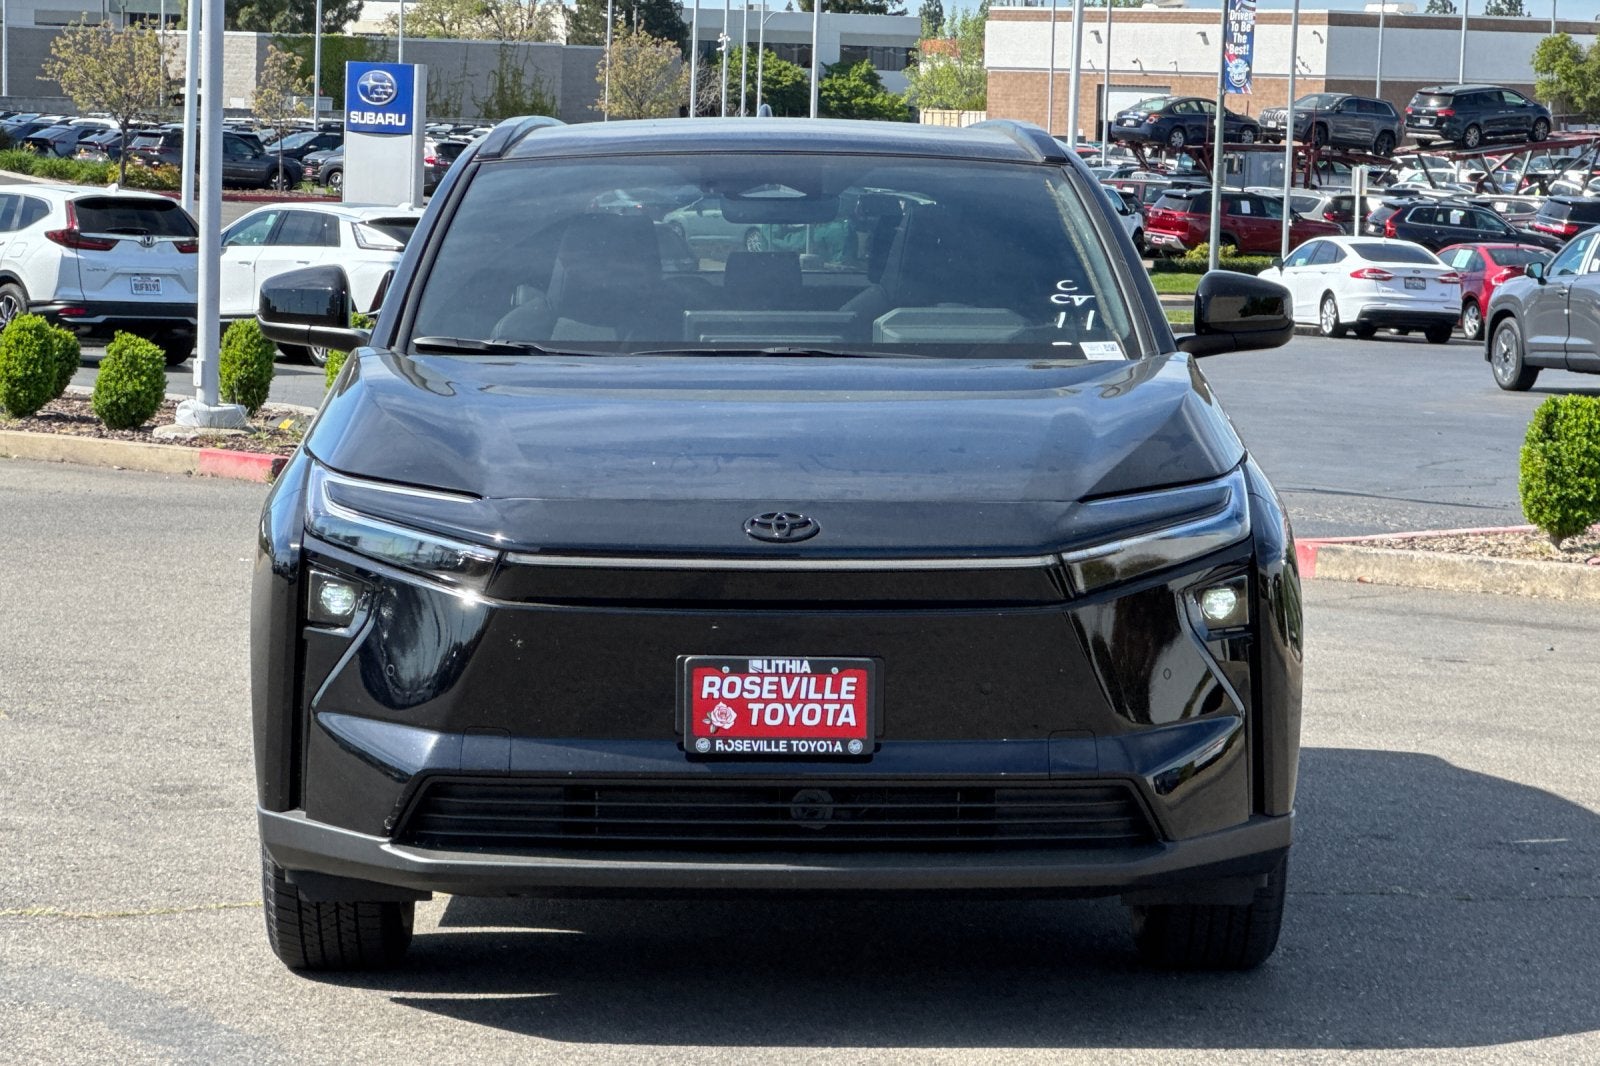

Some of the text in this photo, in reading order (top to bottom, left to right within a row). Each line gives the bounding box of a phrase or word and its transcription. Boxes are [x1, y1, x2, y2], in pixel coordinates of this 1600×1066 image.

[1230, 10, 1253, 20] Driven
[1231, 21, 1251, 31] To Be
[1233, 33, 1247, 43] The
[1229, 44, 1249, 54] Best!
[350, 111, 406, 126] SUBARU
[763, 660, 811, 673] LITHIA
[701, 676, 858, 700] ROSEVILLE
[748, 703, 857, 726] TOYOTA
[716, 740, 843, 752] ROSEVILLE TOYOTA
